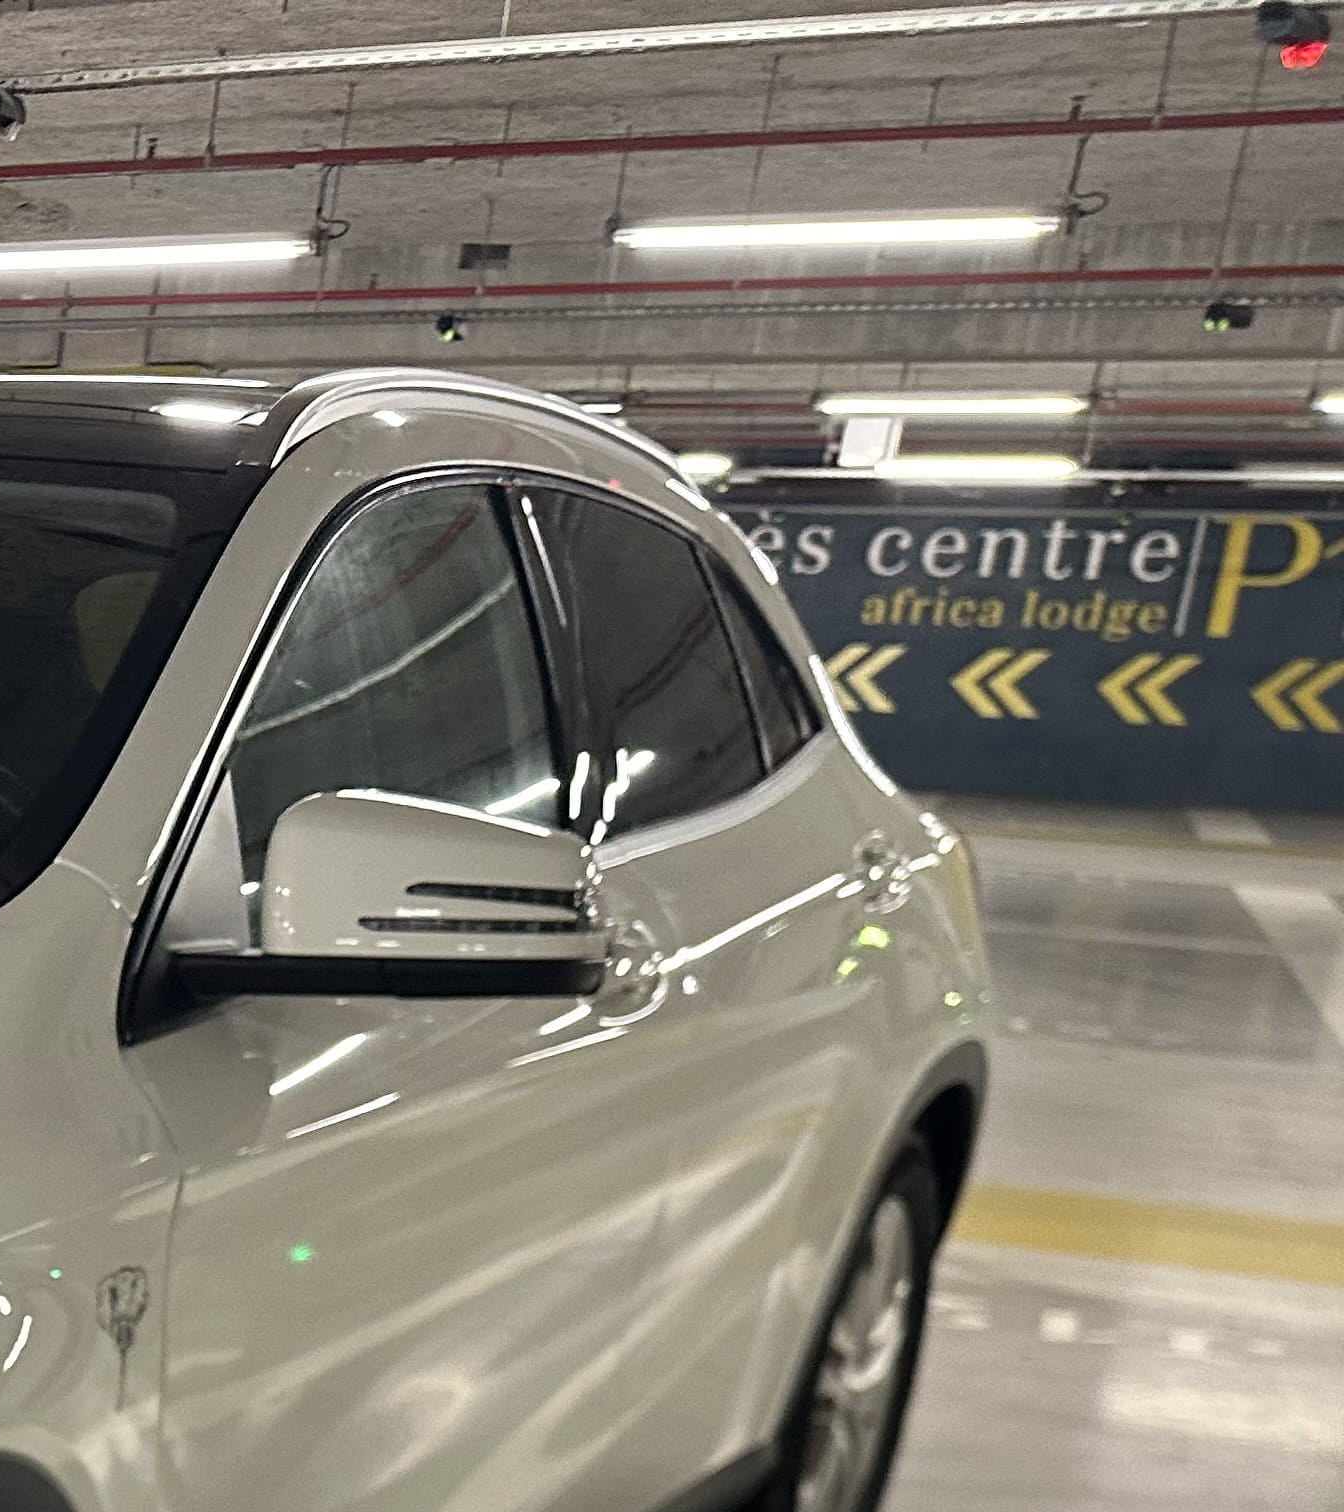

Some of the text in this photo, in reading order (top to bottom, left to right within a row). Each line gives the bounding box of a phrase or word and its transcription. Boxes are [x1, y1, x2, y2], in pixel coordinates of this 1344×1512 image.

[866, 519, 1180, 583] centre
[860, 583, 1167, 643] africa lodge
